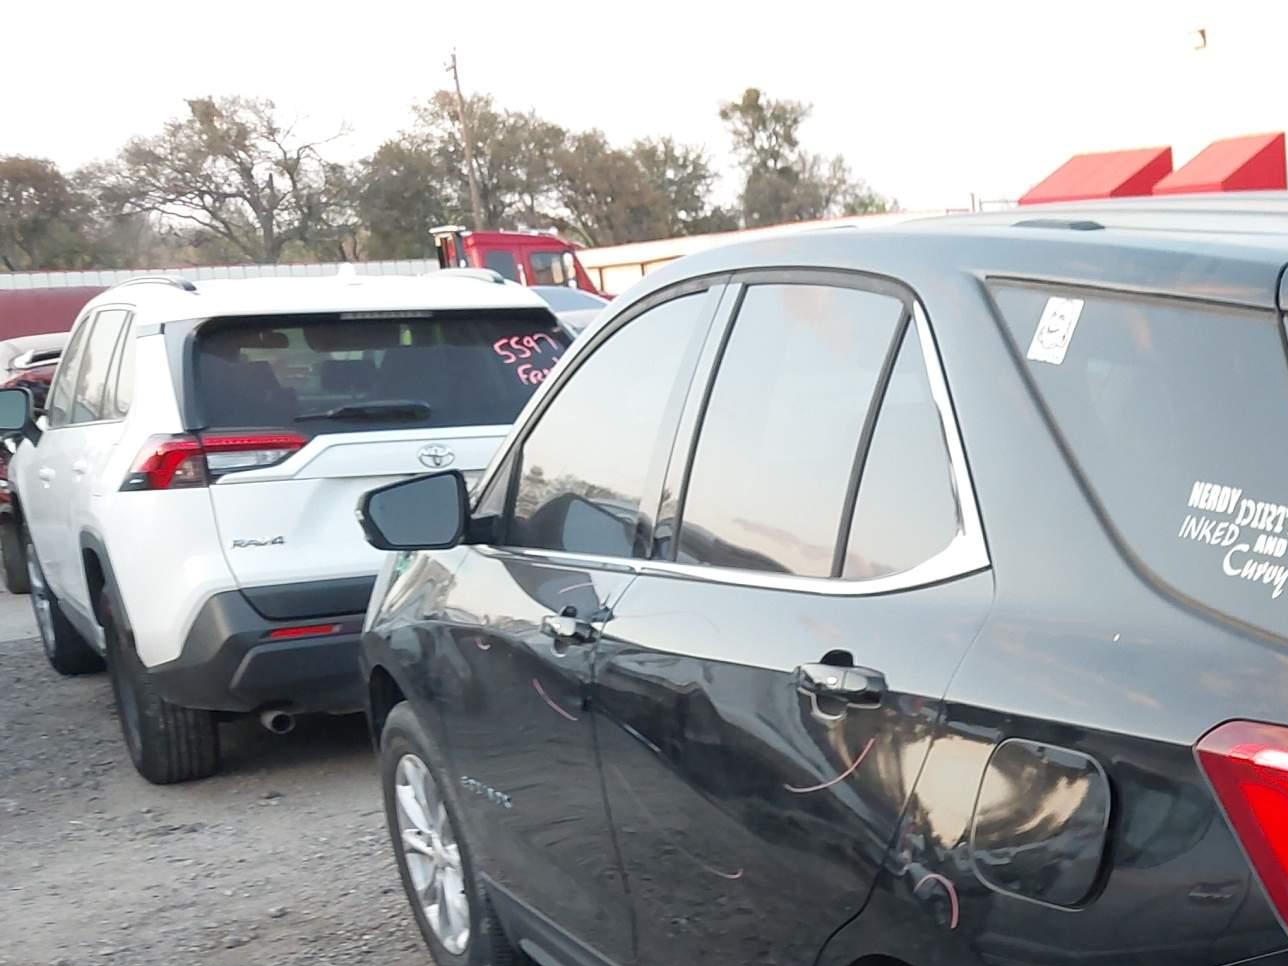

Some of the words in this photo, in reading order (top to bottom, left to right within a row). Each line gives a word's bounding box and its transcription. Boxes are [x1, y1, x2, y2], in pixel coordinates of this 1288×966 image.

[1188, 480, 1242, 515] NERDY
[1178, 514, 1240, 547] INKED
[1253, 534, 1288, 558] AND
